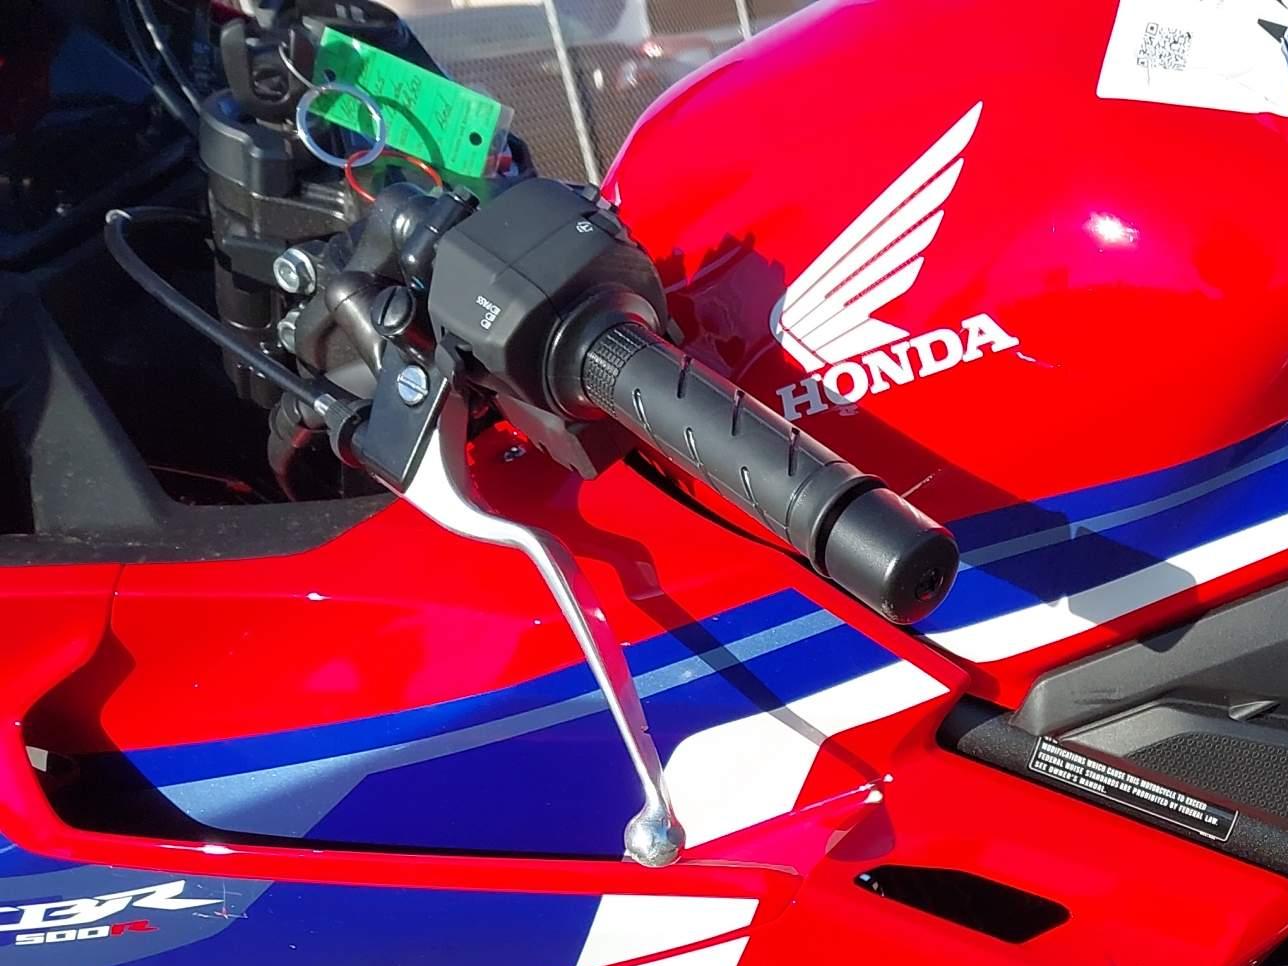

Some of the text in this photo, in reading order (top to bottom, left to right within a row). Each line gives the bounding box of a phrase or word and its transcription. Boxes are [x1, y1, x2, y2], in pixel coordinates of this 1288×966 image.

[775, 312, 1019, 421] HONDA
[1034, 761, 1048, 771] SEE
[1038, 751, 1064, 767] FEDERAL
[1064, 761, 1084, 775] NOISE
[1084, 769, 1120, 788] STANDARDS
[1119, 783, 1132, 793] ARE
[1131, 786, 1169, 807] PROHIBITED
[1178, 805, 1203, 821] FEDERAL
[1041, 742, 1087, 765] MODIFICATIONS
[1086, 758, 1106, 772] WHICH
[1106, 767, 1126, 780] CAUSE
[1126, 774, 1140, 786] THIS
[1140, 779, 1176, 800] MOTORCYCLE
[15, 919, 159, 946] 500R
